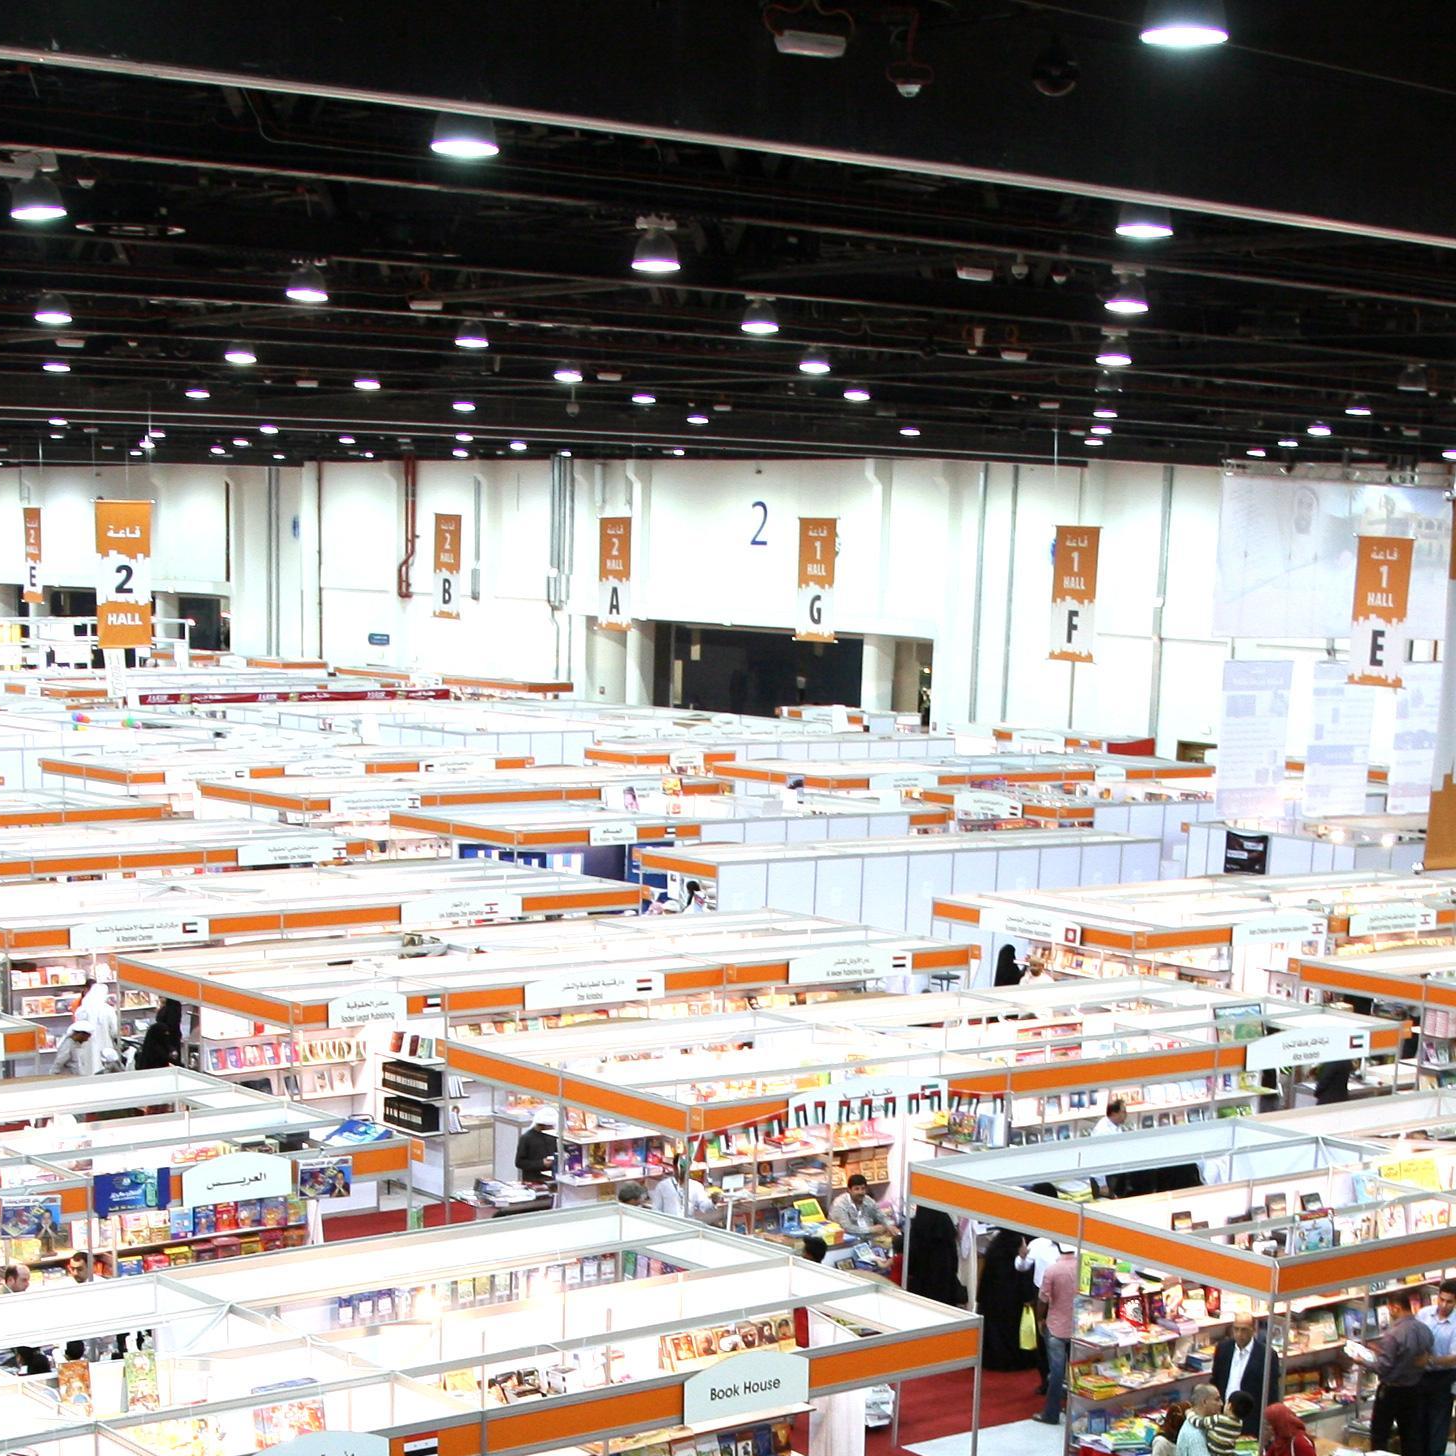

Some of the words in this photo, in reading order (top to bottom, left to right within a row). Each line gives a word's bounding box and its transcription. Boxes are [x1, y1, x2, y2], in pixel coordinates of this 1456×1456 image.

[106, 524, 141, 538] قاعة
[750, 501, 768, 546] 2
[29, 529, 36, 543] 2
[444, 533, 451, 549] 2
[1065, 534, 1088, 548] قاعة
[611, 537, 619, 556] 2
[814, 540, 821, 560] 1
[1370, 547, 1398, 562] قاعة
[440, 552, 454, 563] HALL
[606, 559, 623, 570] HALL
[1070, 551, 1079, 572] 1
[29, 566, 37, 587] E
[115, 564, 134, 594] 2
[807, 563, 826, 576] HALL
[1379, 566, 1389, 588] 1
[442, 578, 452, 604] B
[1063, 576, 1085, 590] HALL
[609, 586, 620, 615] A
[809, 594, 822, 625] G
[1367, 592, 1394, 608] HALL
[107, 612, 142, 625] HALL
[1066, 609, 1079, 644] F
[1369, 629, 1385, 667] E
[370, 1011, 395, 1021] Publishing
[710, 1383, 740, 1401] Book
[743, 1378, 781, 1395] House
